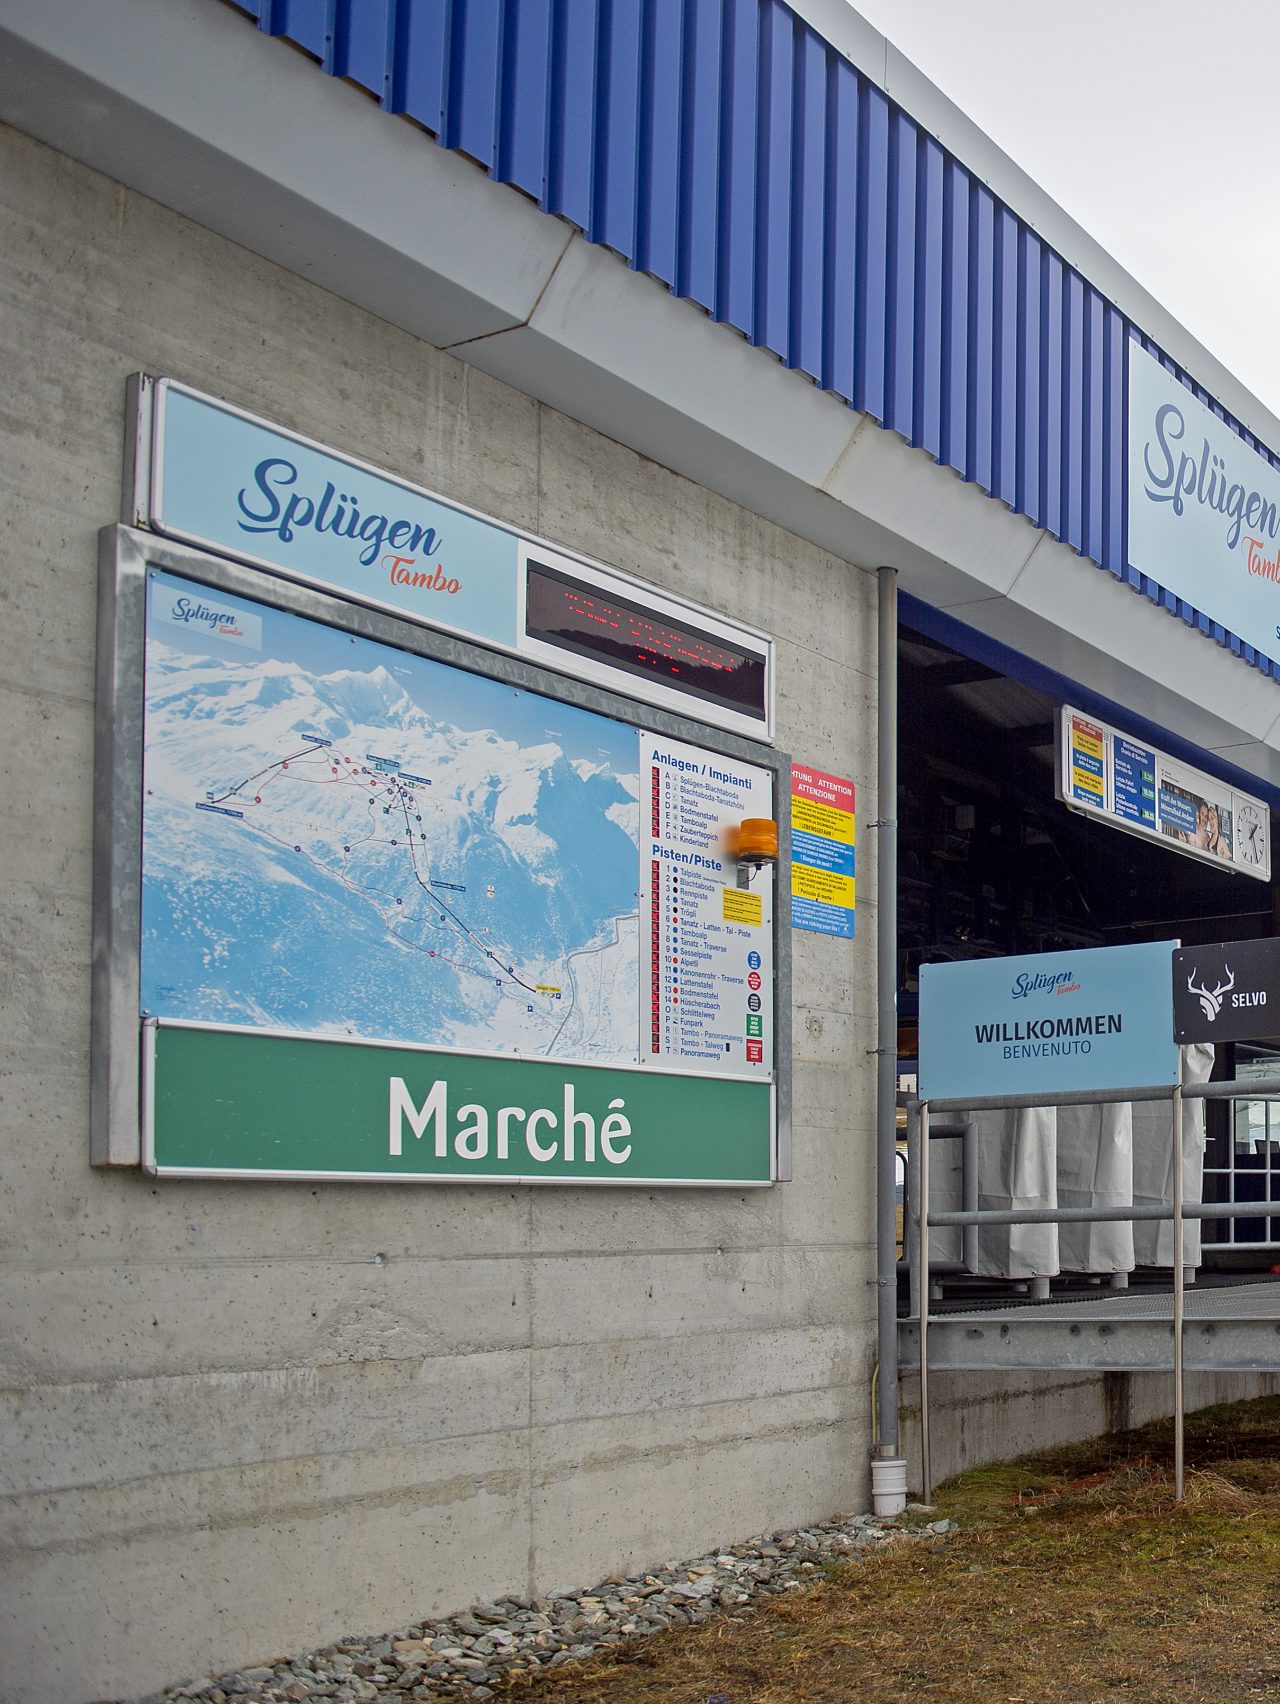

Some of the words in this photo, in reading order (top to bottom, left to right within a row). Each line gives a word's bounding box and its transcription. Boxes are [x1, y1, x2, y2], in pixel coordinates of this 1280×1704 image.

[1144, 404, 1280, 550] Splügen
[237, 458, 442, 566] Splügen
[381, 555, 463, 594] Tambo
[172, 598, 236, 628] Splügen
[218, 625, 244, 636] Tambo
[652, 750, 698, 773] Anlagen
[709, 766, 752, 790] Impianti
[792, 770, 812, 782] HTUNG
[818, 779, 852, 796] ATTENTION
[798, 783, 836, 801] ATTENZIONE
[680, 796, 699, 807] Tanatz
[680, 805, 718, 822] Bodmenstafel
[681, 816, 708, 829] Tamboalp
[680, 825, 718, 841] Zauberteppich
[680, 836, 708, 848] Kinderland
[652, 844, 722, 871] Pisten/Piste
[680, 868, 701, 879] Talpiste
[680, 898, 698, 908] Tanatz
[680, 908, 696, 918] Trögli
[680, 918, 698, 928] Tanatz
[738, 929, 751, 938] Piste
[680, 928, 707, 940] Tamboalp
[680, 938, 698, 948] Tanatz
[704, 942, 727, 953] Traverse
[722, 974, 744, 984] Traverse
[1012, 971, 1074, 999] Splügen
[680, 988, 718, 1000] Bodmenstafel
[1056, 982, 1081, 995] Tambo
[1232, 991, 1267, 1008] SELVO
[680, 1018, 704, 1027] Funpark
[975, 1014, 1122, 1043] WILLKOMMEN
[681, 1028, 700, 1037] Tambo
[681, 1038, 699, 1048] Tambo
[705, 1041, 723, 1051] Talweg
[1003, 1040, 1091, 1059] BENVENUTO
[680, 1048, 720, 1060] Panoramaweg
[389, 1076, 632, 1164] Marché
